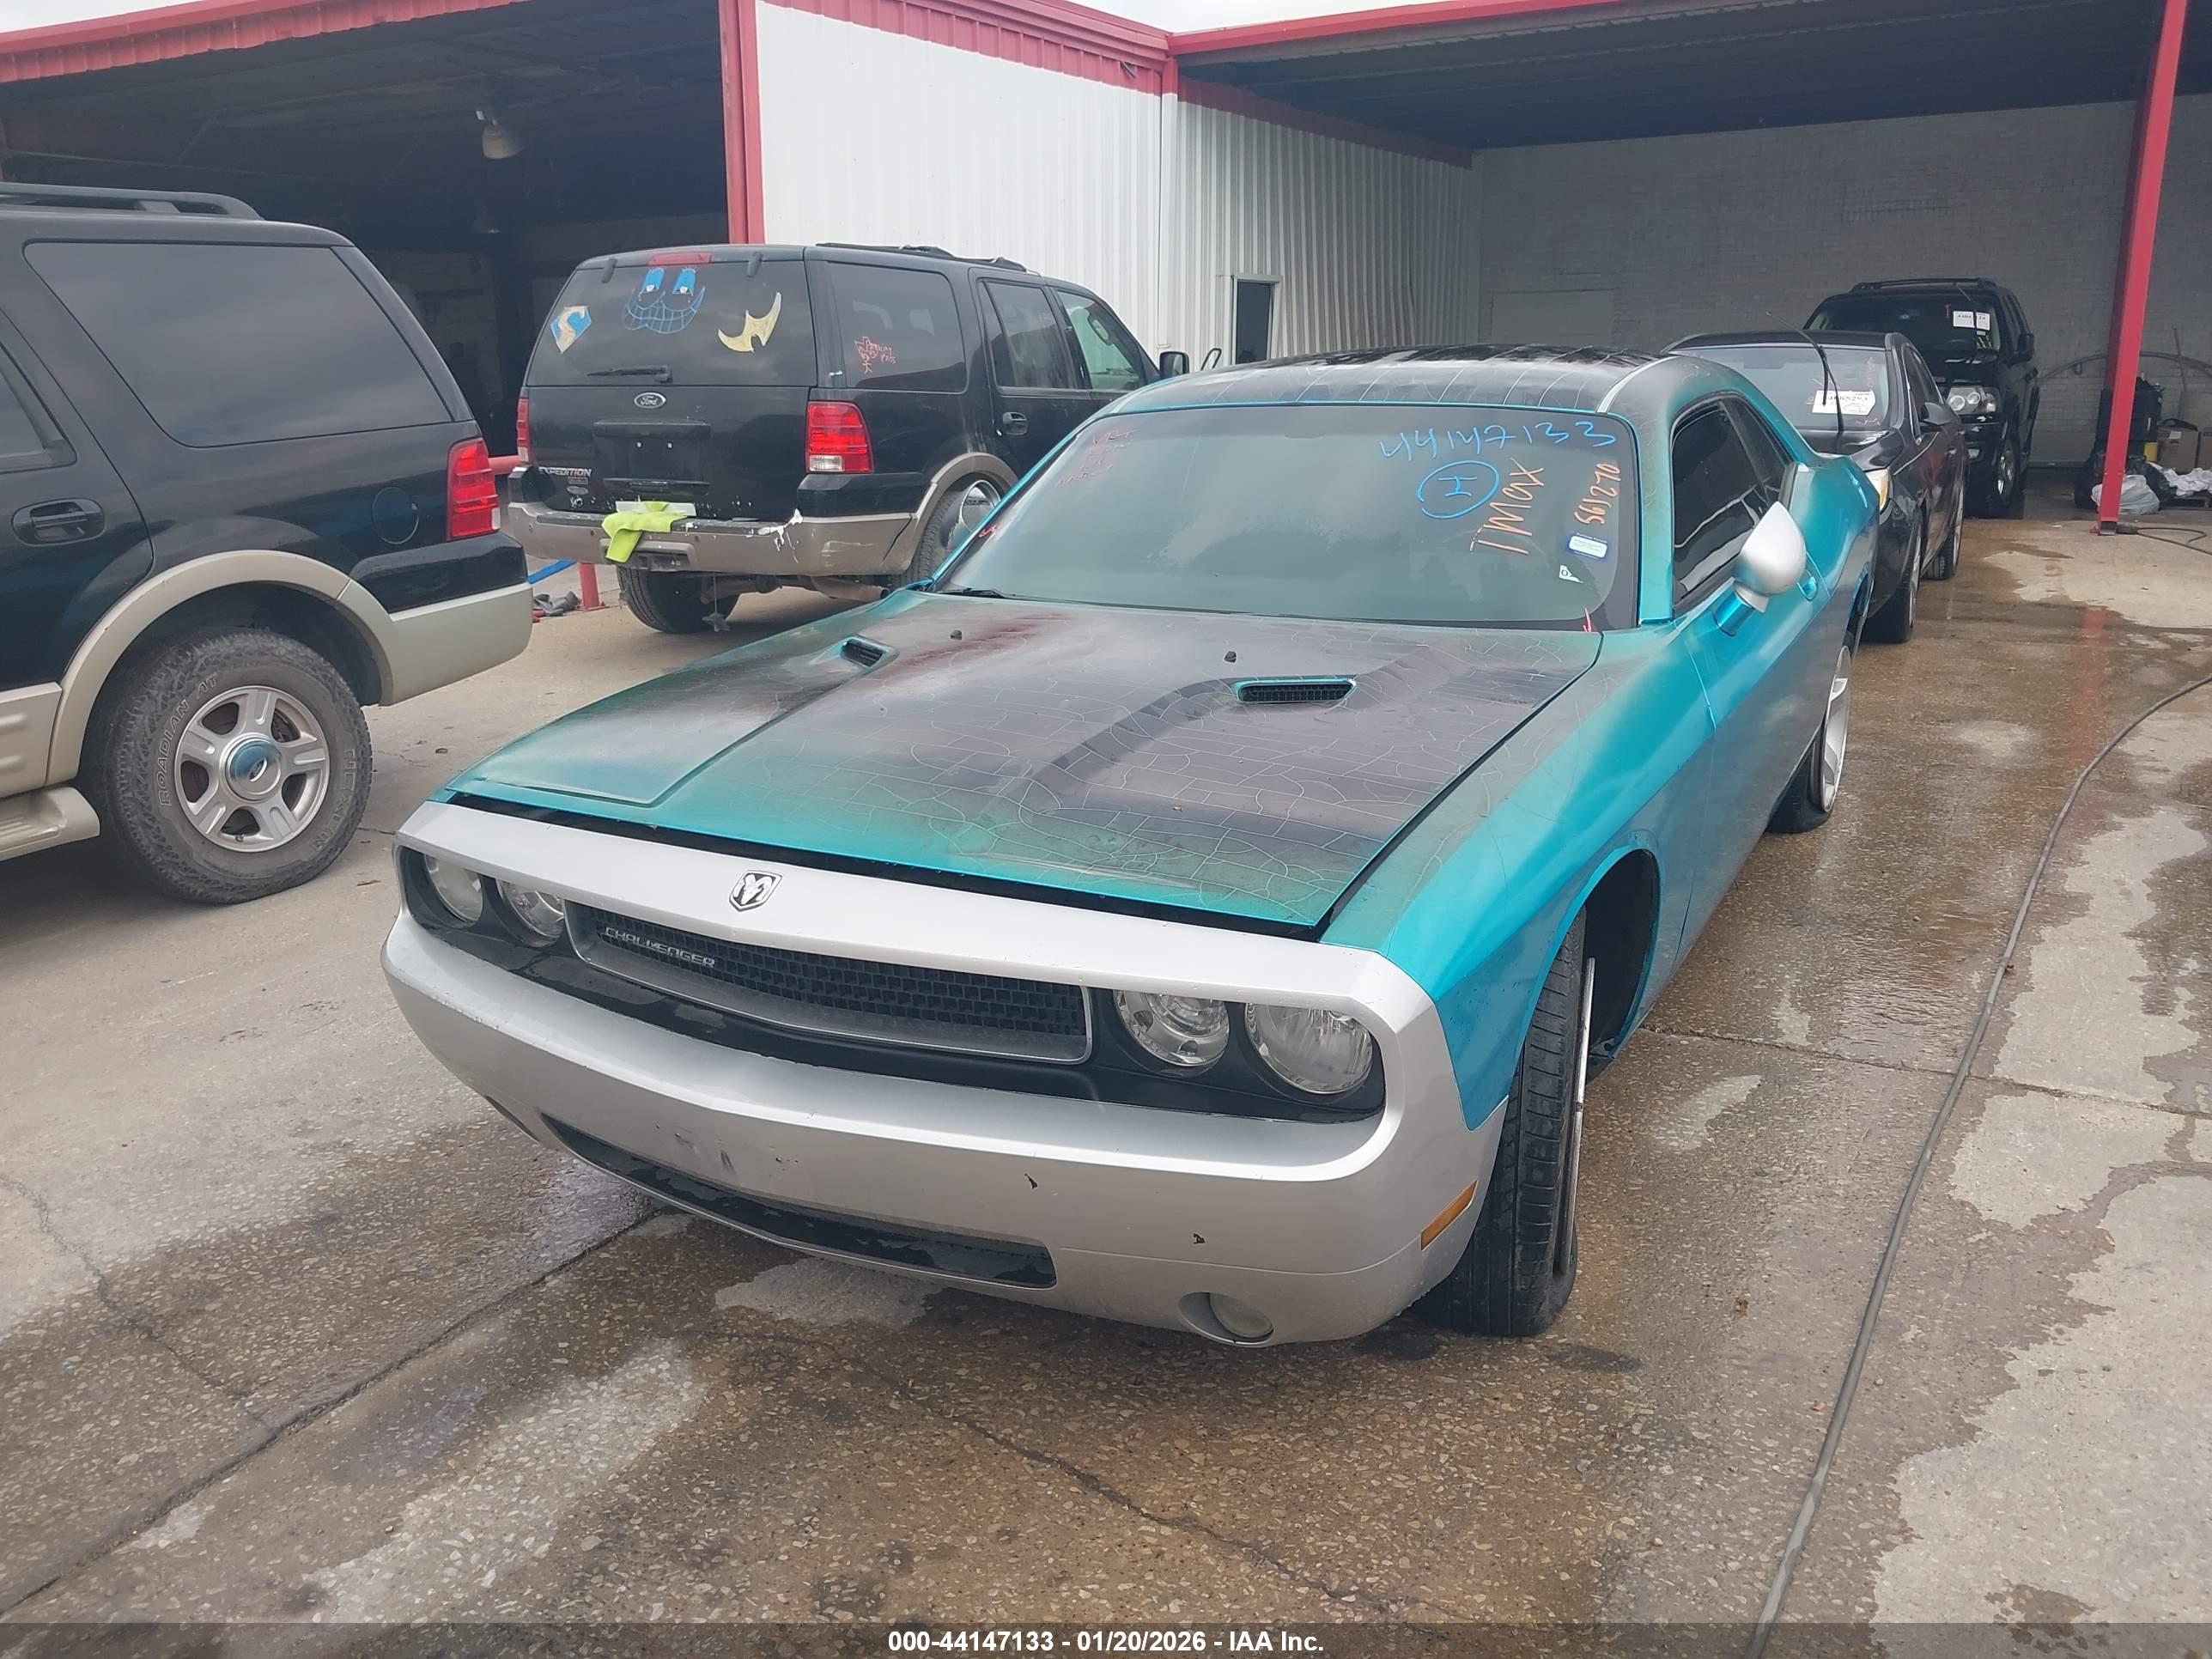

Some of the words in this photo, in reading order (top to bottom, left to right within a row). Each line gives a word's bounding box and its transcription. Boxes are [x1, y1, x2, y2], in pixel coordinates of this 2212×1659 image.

[1379, 420, 1616, 461] 44147133
[538, 466, 592, 477] EXPEDITION
[156, 698, 190, 807] ROADIAN
[196, 672, 219, 700] AT
[604, 926, 716, 969] CHALLENGER
